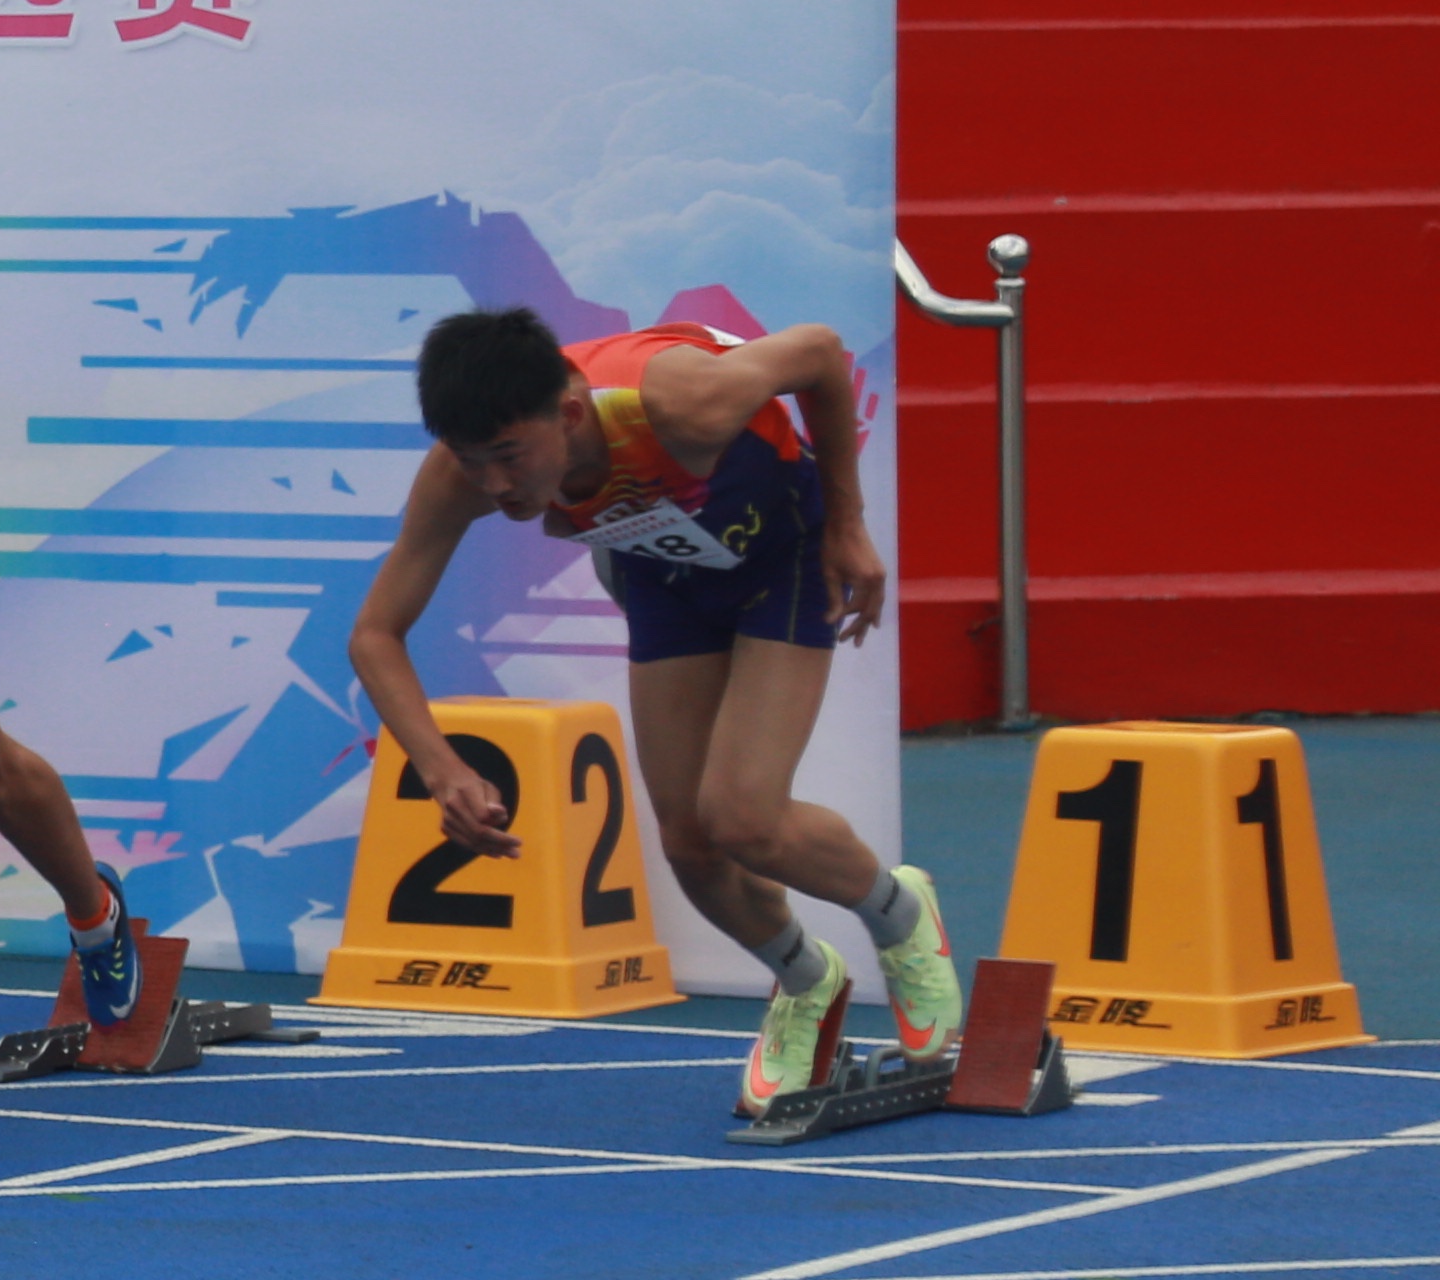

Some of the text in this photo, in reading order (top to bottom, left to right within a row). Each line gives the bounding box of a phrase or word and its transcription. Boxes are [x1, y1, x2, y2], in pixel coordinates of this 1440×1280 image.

[387, 733, 520, 929] 2
[570, 732, 636, 929] 2
[1055, 759, 1144, 963] 1
[1235, 758, 1294, 962] 1
